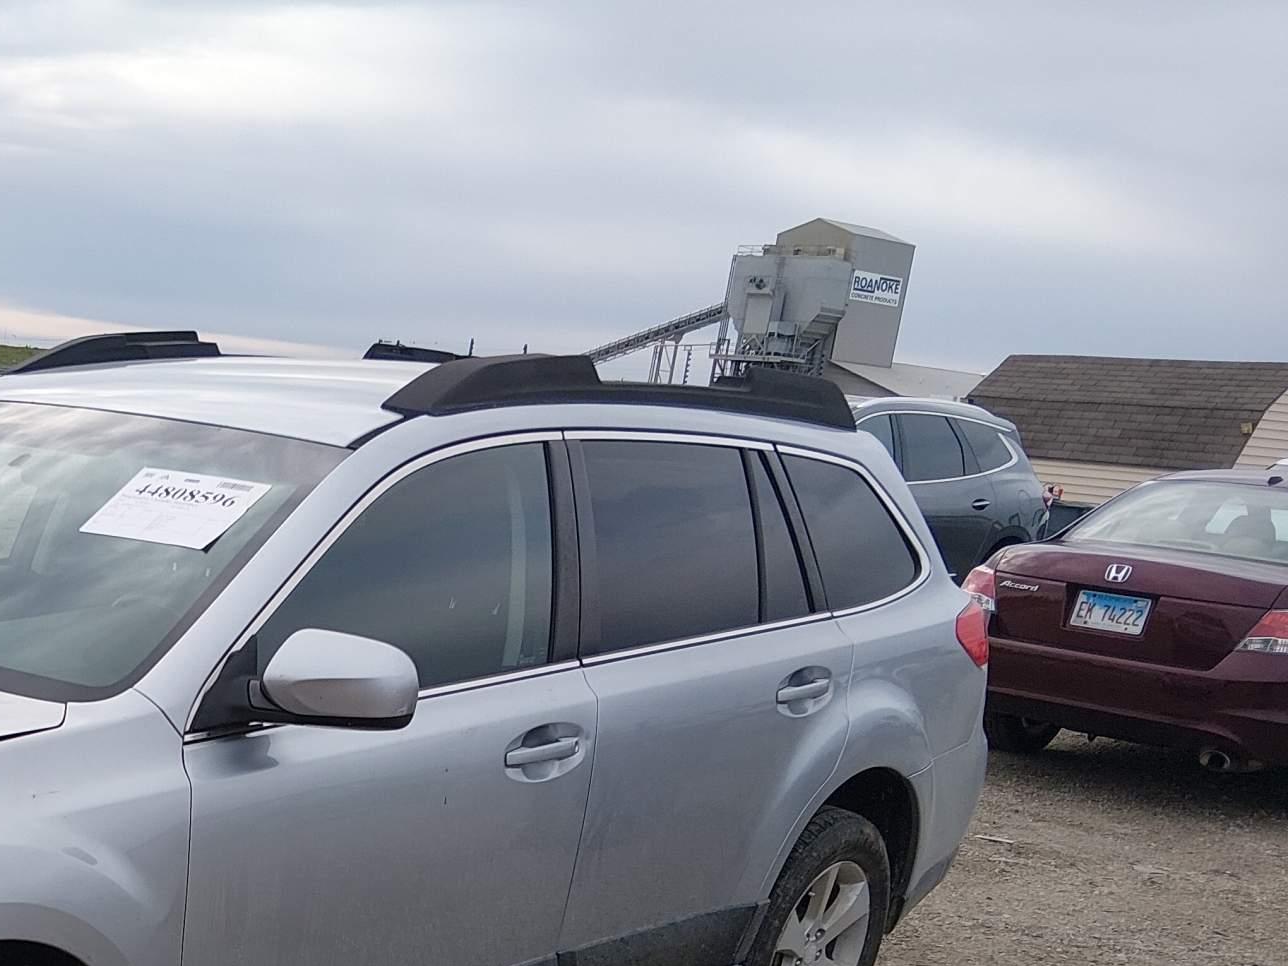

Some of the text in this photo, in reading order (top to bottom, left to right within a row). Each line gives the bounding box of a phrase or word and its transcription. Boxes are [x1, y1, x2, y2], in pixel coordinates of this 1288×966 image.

[853, 276, 901, 294] ROANOKE
[136, 483, 237, 508] 44808596
[999, 580, 1040, 592] Accord
[1101, 604, 1144, 627] 74222
